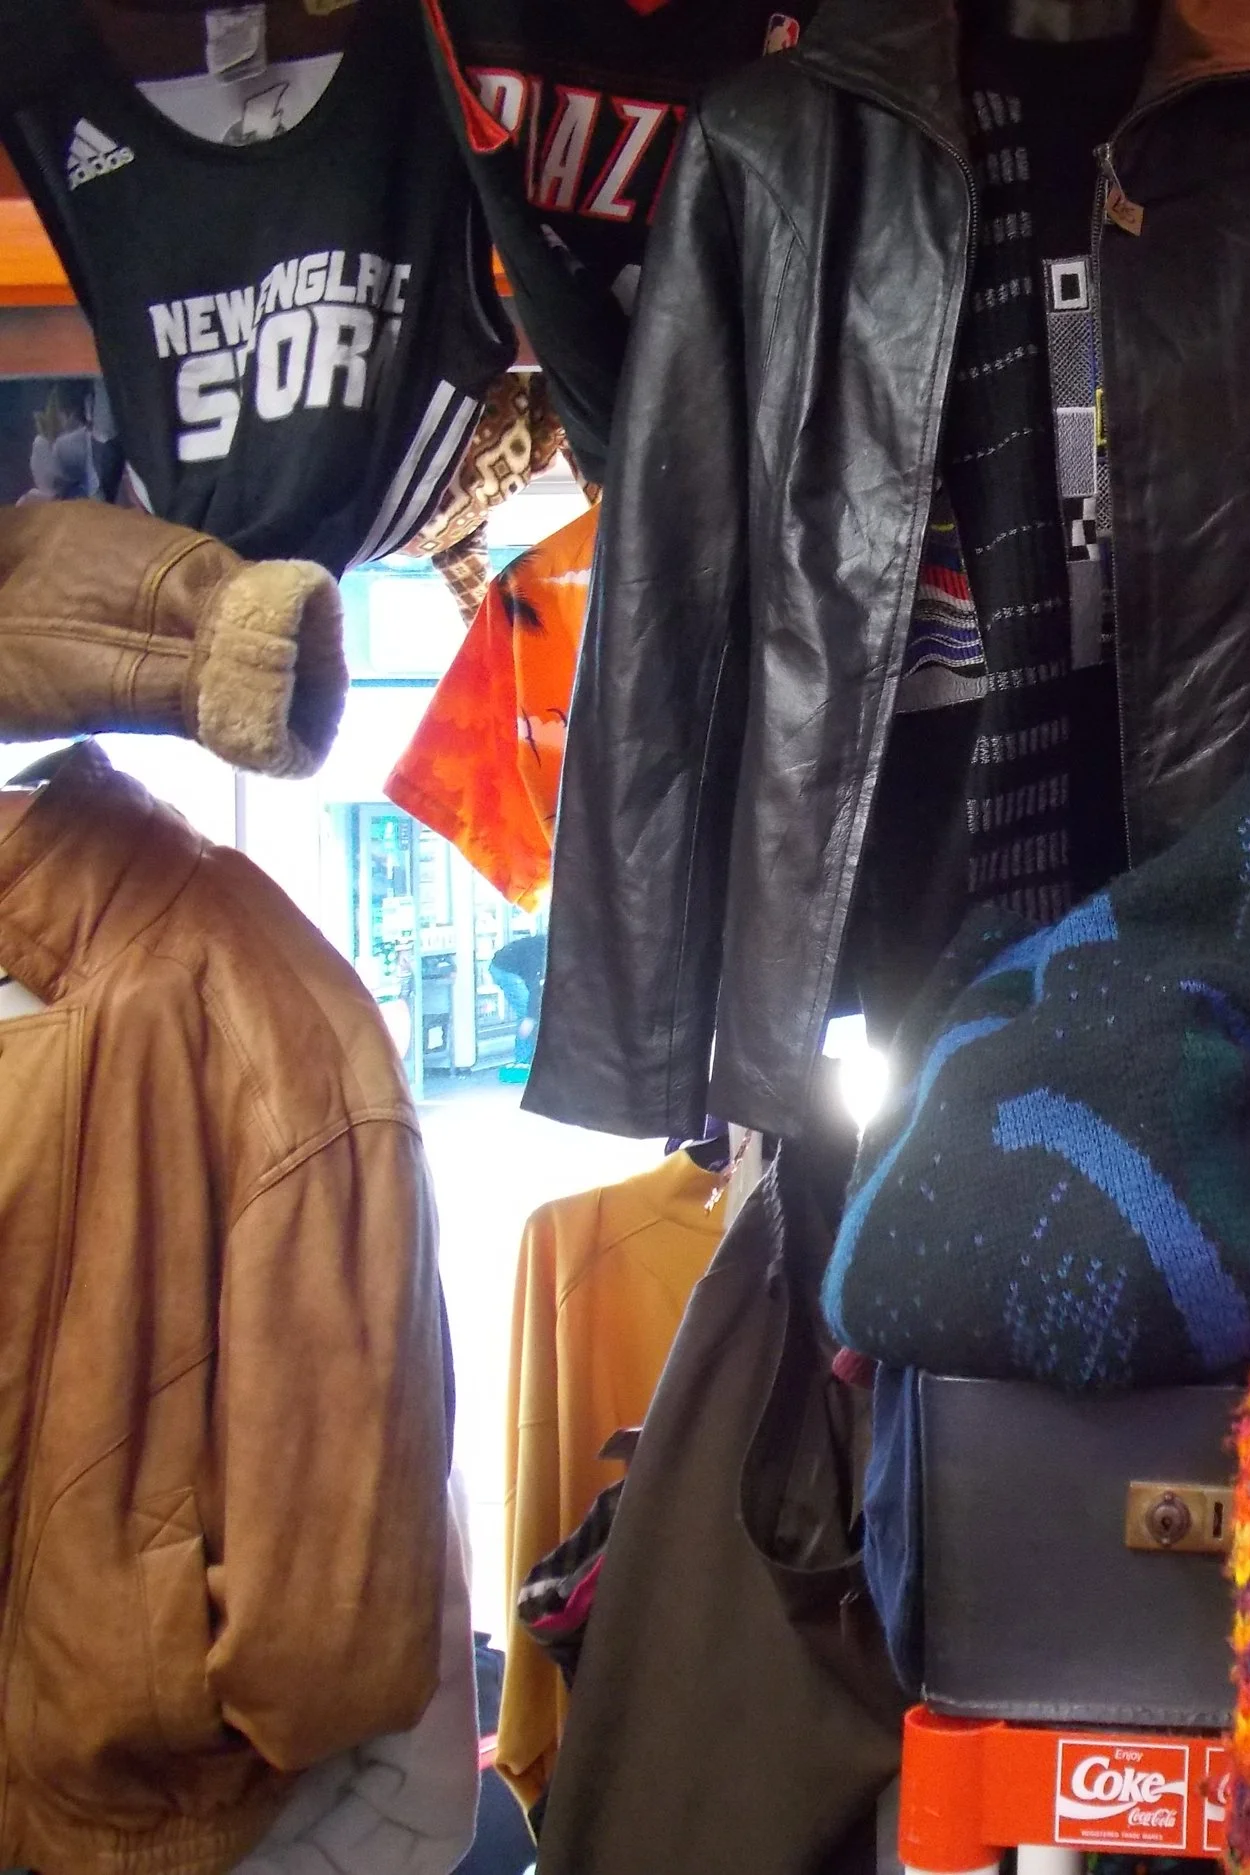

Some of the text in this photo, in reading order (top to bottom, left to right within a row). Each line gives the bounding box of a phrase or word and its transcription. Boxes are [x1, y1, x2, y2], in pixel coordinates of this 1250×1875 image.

[68, 147, 134, 191] adidas
[149, 286, 256, 359] NEW
[1114, 1748, 1144, 1762] Enjoy
[1072, 1755, 1167, 1803] Coke
